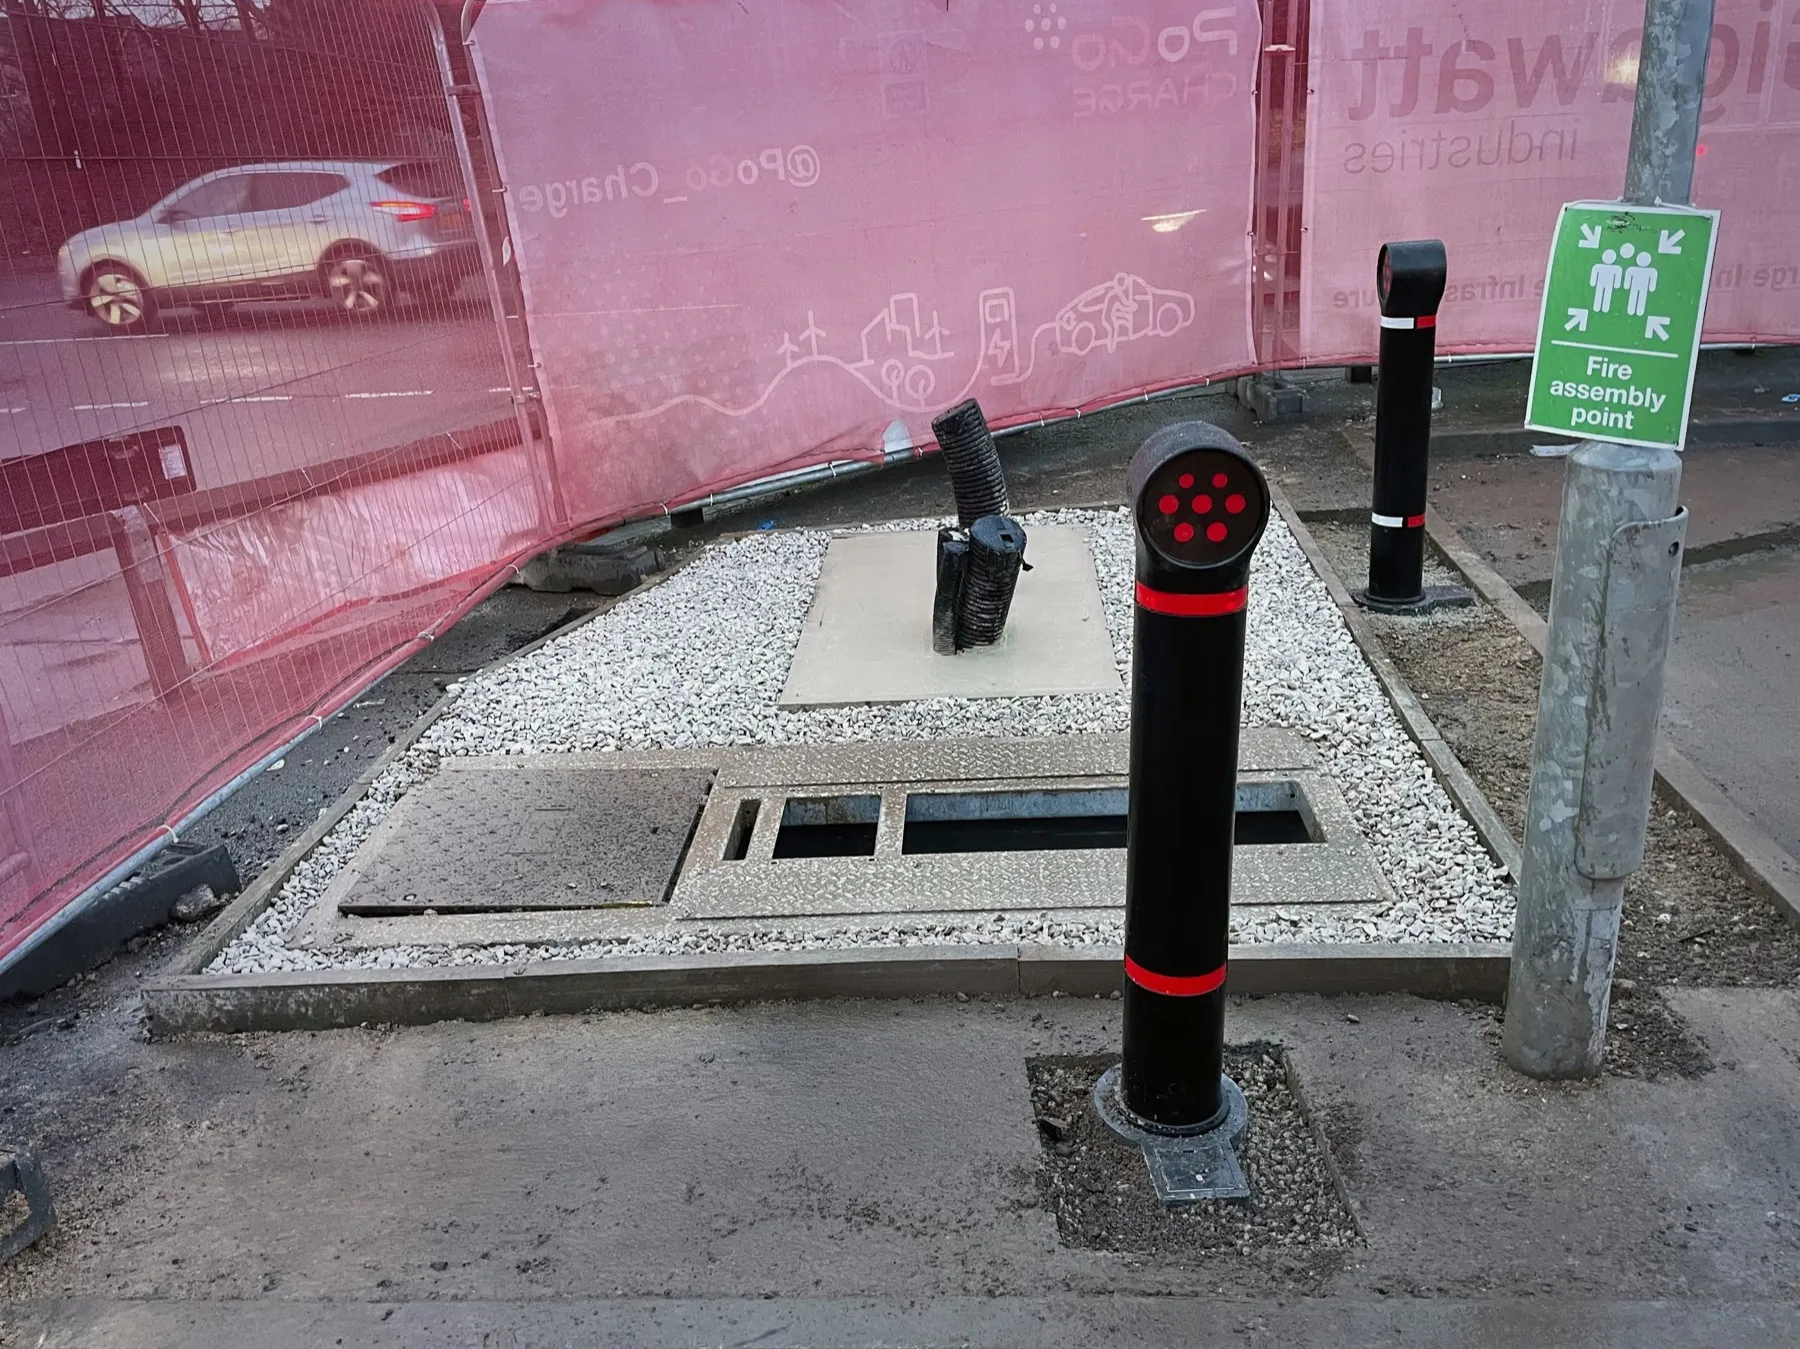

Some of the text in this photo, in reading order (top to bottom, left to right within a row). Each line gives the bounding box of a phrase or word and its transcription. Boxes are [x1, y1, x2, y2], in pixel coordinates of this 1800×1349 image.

[1586, 355, 1633, 381] Fire
[1549, 379, 1667, 414] assembly
[1570, 406, 1635, 431] point
